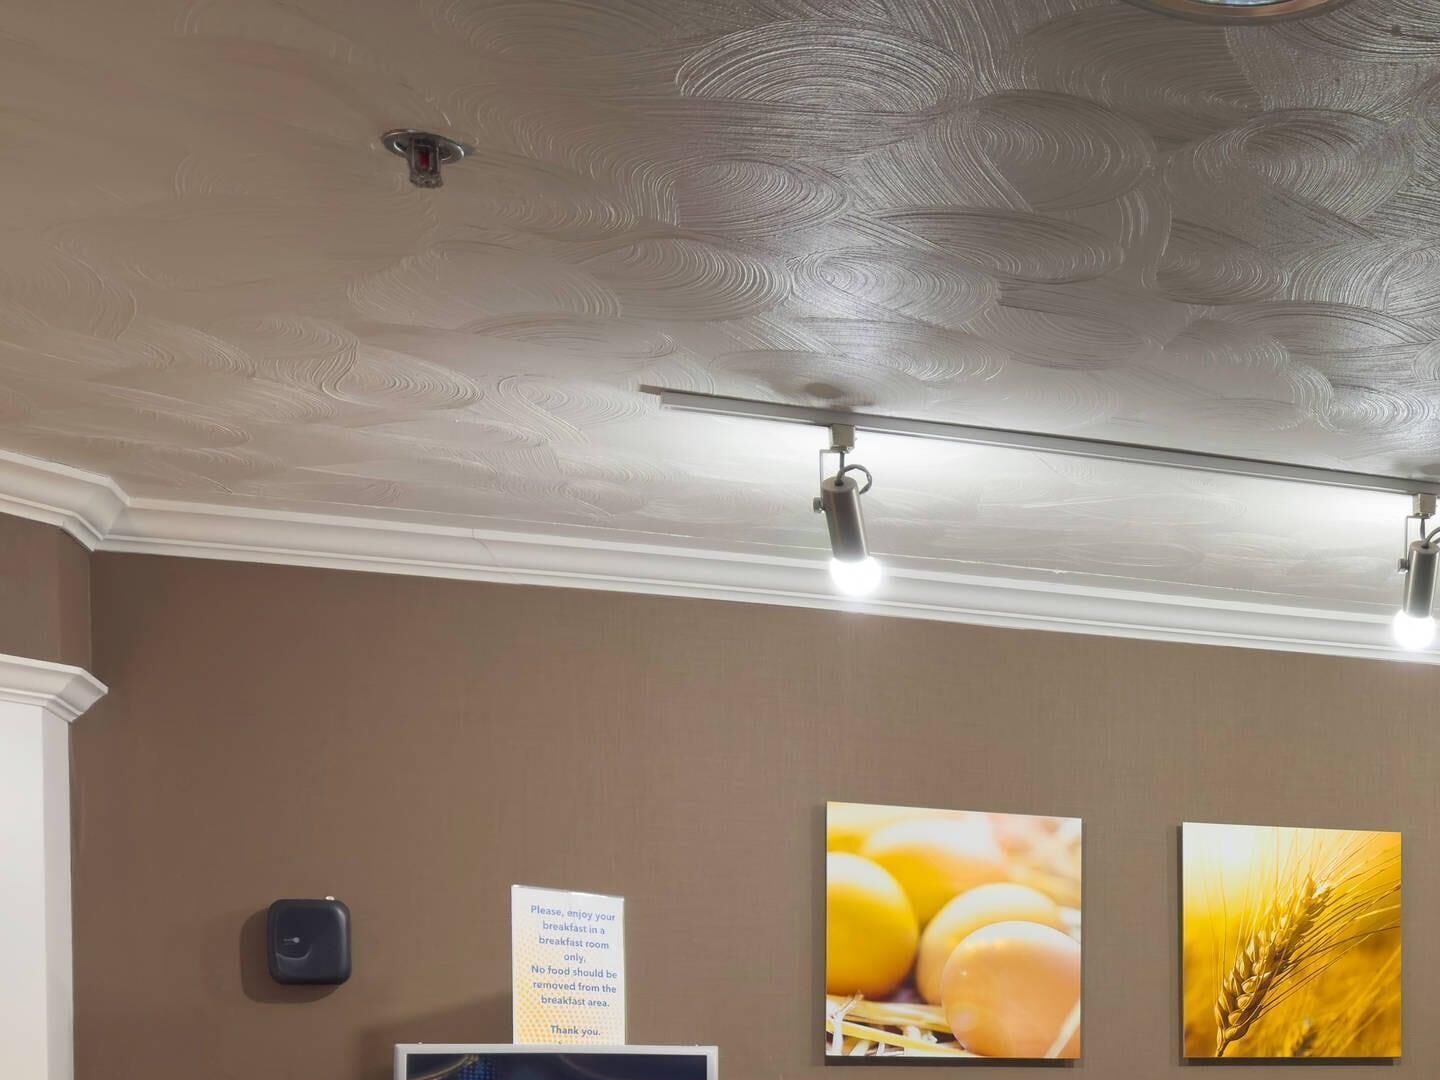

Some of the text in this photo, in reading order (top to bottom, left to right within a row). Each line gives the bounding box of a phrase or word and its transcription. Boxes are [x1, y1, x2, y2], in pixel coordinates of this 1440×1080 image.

[530, 904, 616, 922] Please, enjoy your
[542, 920, 605, 935] breakfast in a
[538, 935, 609, 949] breakfast room
[531, 965, 618, 979] No food should be
[533, 981, 617, 993] removed from the
[541, 994, 610, 1008] breakfast area.
[551, 1025, 601, 1037] Thank you.
